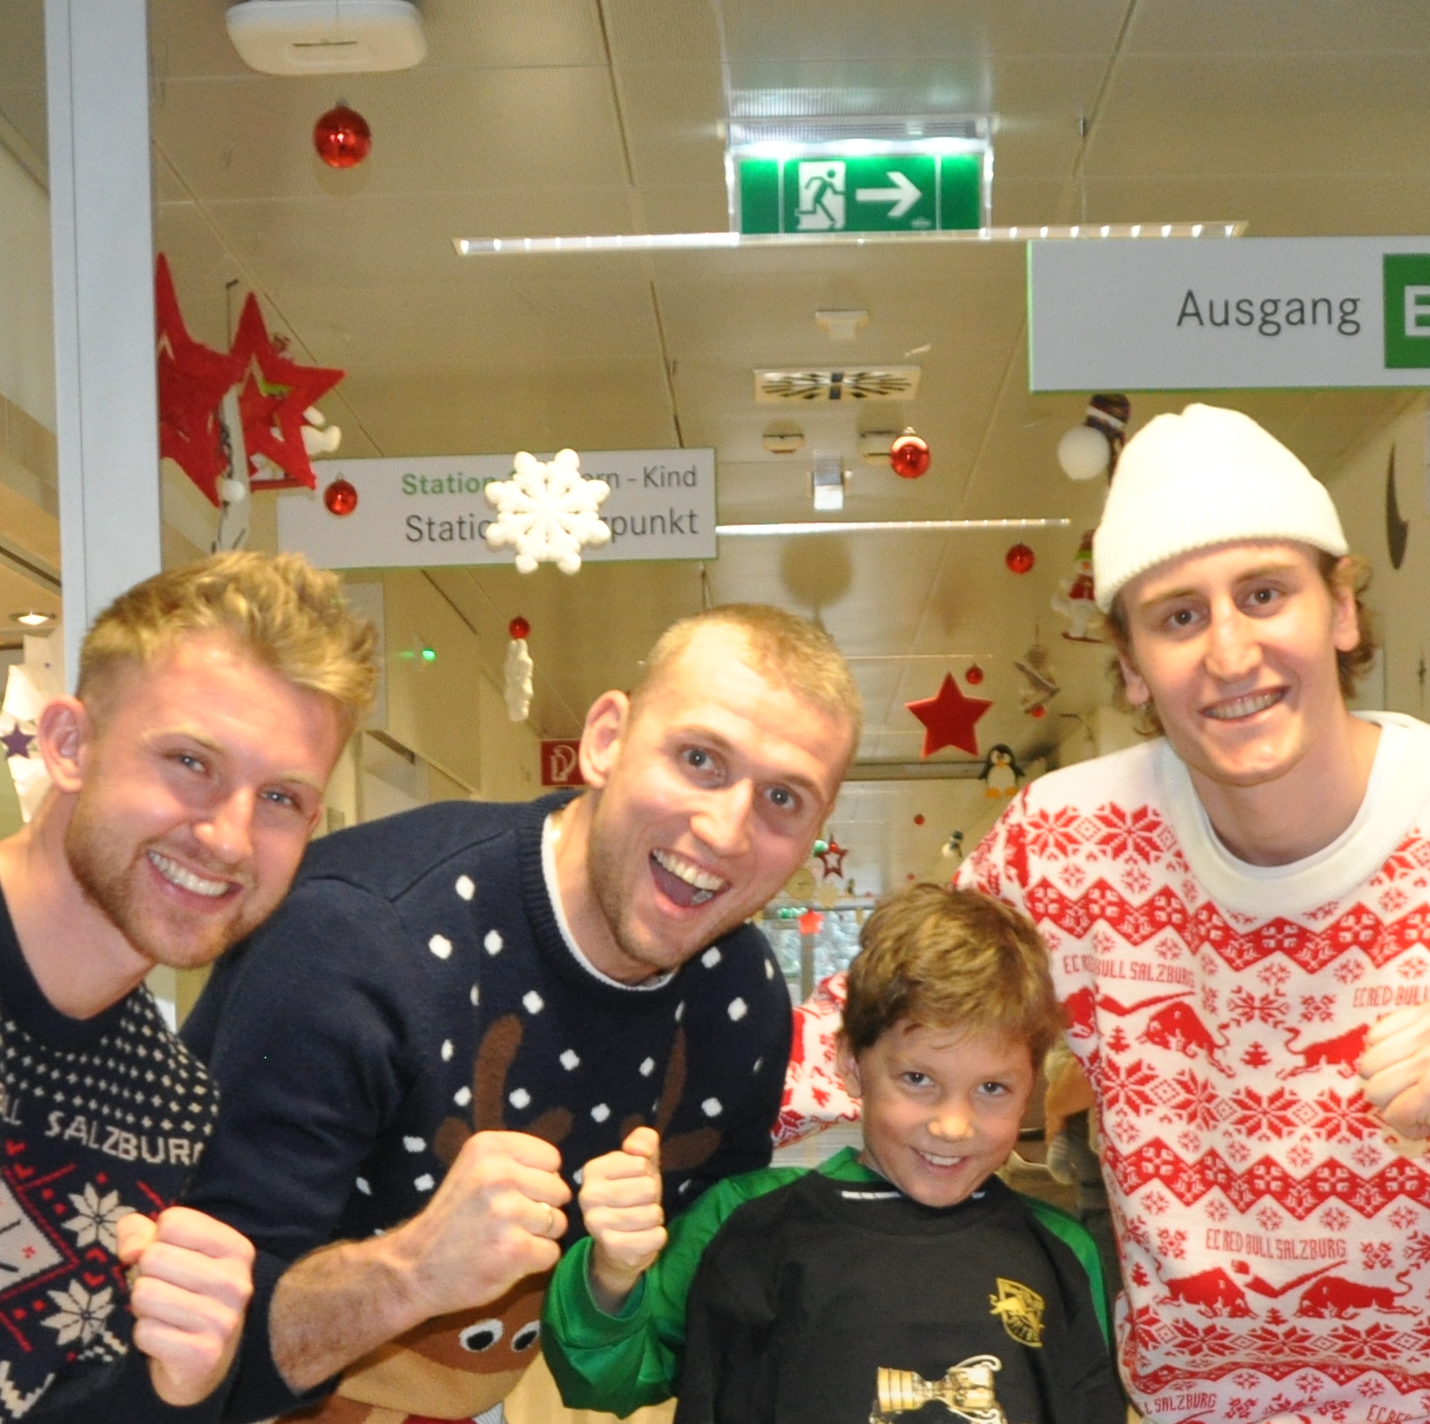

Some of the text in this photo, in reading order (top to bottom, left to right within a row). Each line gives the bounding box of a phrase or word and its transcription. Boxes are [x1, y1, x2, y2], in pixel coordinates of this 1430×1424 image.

[1176, 288, 1361, 338] Ausgang
[642, 464, 697, 489] Kind
[1222, 1229, 1244, 1253] RED
[1275, 1237, 1347, 1261] SALZBURG
[1155, 1392, 1218, 1413] SALZBURG
